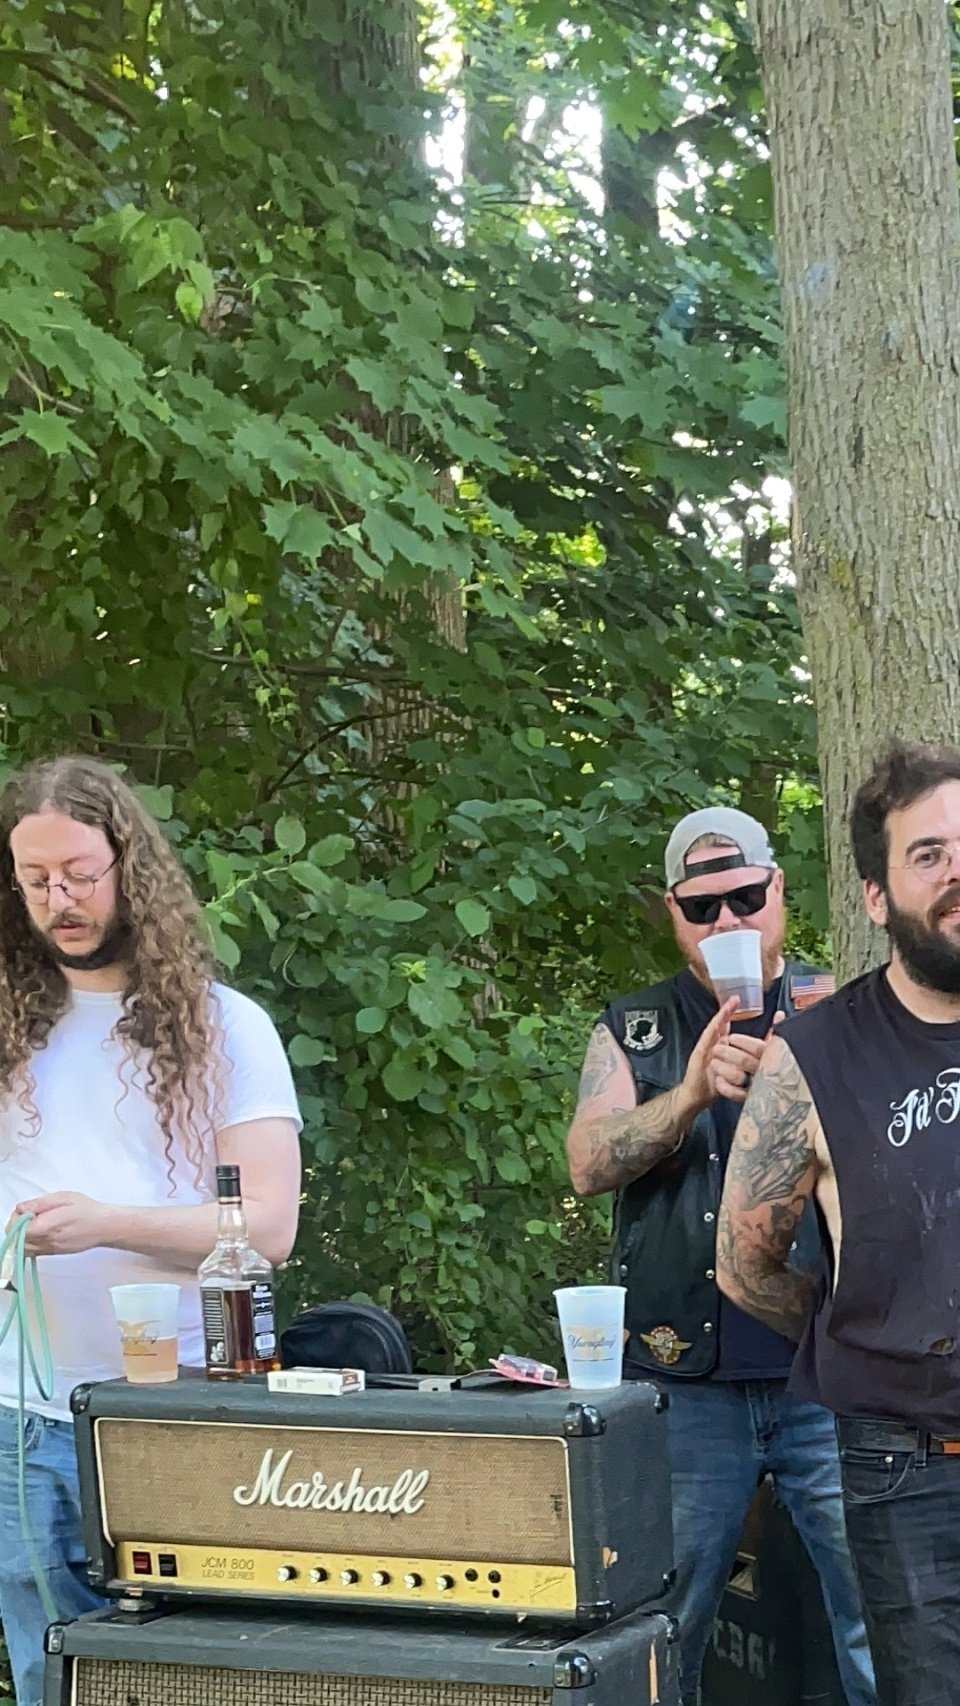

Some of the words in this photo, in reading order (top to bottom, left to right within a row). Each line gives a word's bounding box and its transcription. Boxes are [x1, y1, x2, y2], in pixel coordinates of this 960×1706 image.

[233, 1448, 430, 1514] Marshall
[201, 1557, 227, 1569] JCM
[230, 1558, 255, 1571] 800
[202, 1569, 225, 1579] LEAD
[227, 1570, 256, 1581] SERIES
